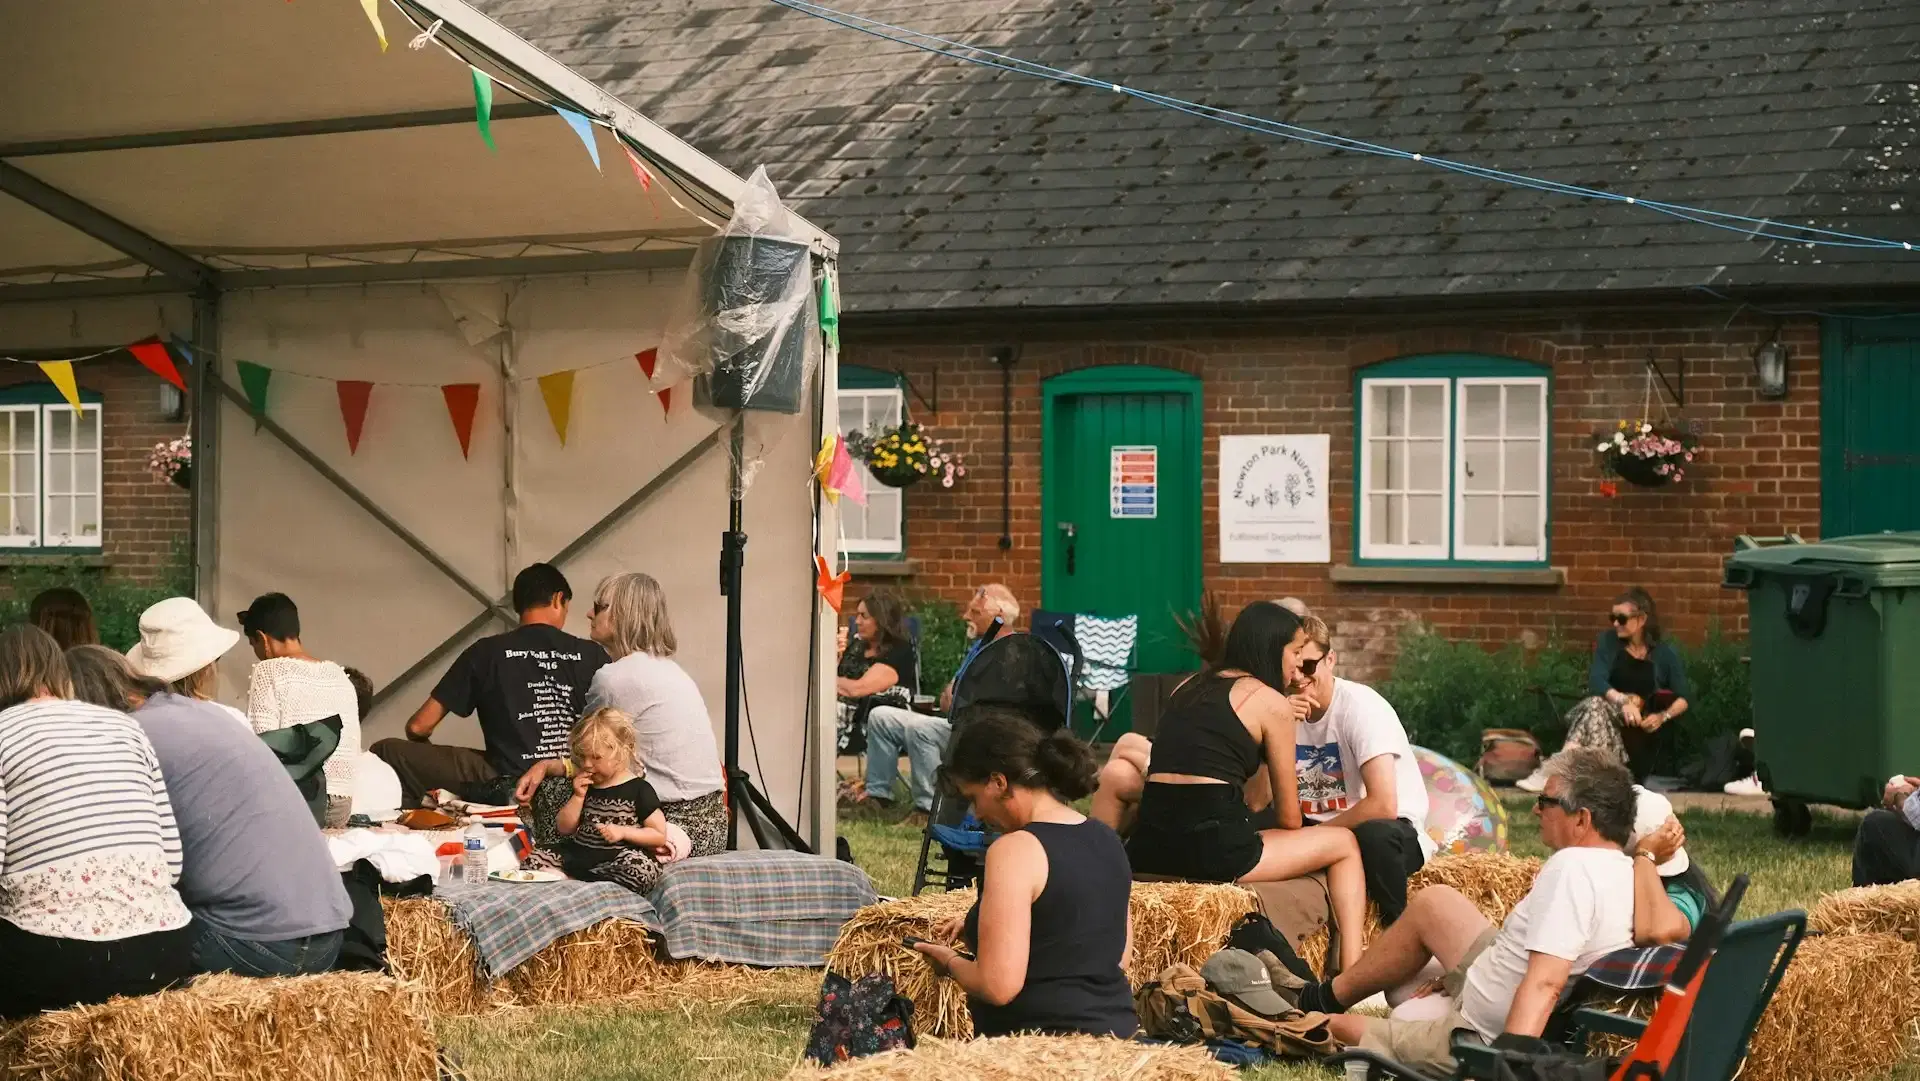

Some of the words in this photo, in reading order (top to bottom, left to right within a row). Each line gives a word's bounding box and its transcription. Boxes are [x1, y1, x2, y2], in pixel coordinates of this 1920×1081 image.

[1233, 453, 1260, 499] Nowton
[1261, 445, 1288, 456] Park
[1290, 450, 1316, 498] Nursery
[505, 650, 529, 659] Bury
